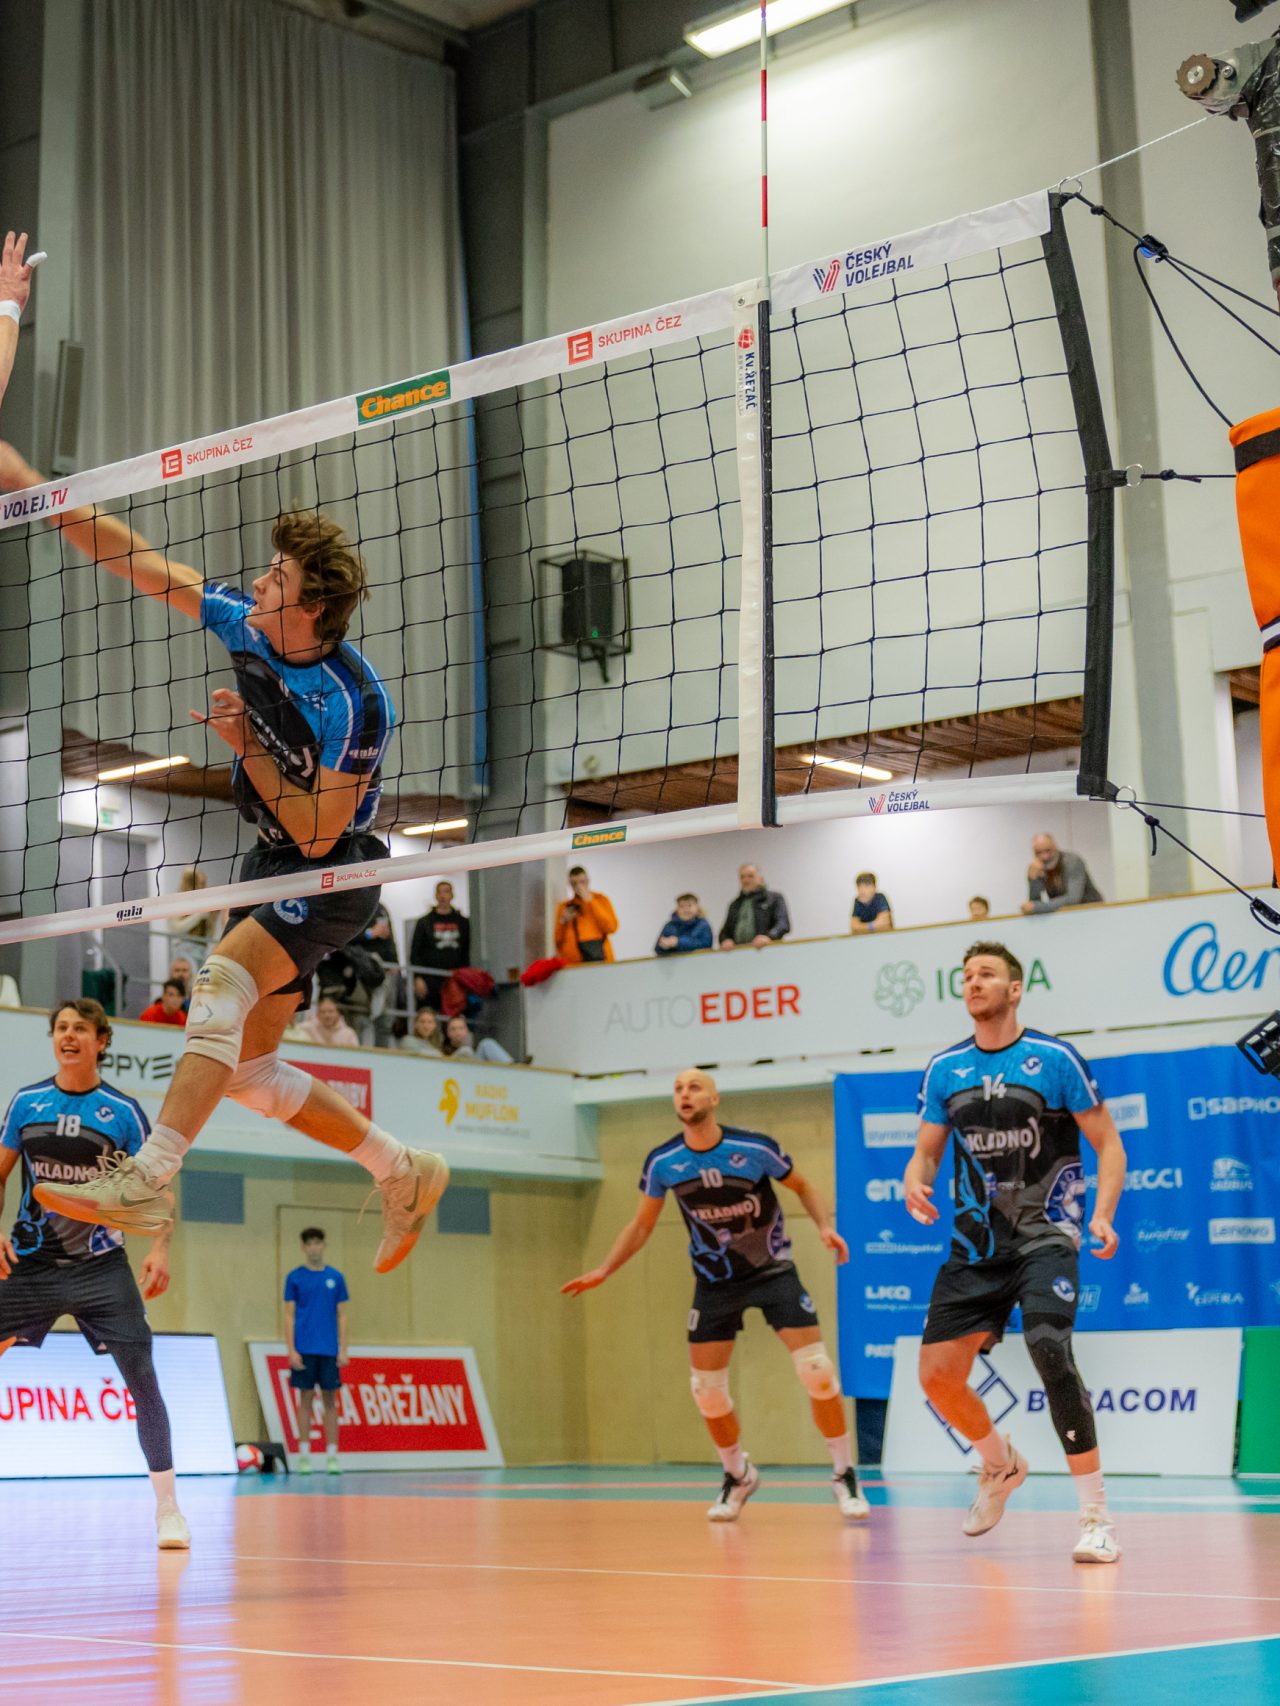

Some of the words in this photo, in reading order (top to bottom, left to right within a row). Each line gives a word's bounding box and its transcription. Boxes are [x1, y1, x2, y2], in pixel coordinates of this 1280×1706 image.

[845, 240, 892, 271] ČESKÝ
[845, 254, 915, 288] VOLEJBAL
[597, 323, 653, 349] SKUPINA
[654, 313, 682, 337] ČEZ
[361, 378, 448, 420] Chance
[186, 443, 231, 466] SKUPINA
[232, 436, 254, 456] ČEZ
[2, 487, 69, 521] VOLEJ.TV
[887, 799, 931, 813] VOLEJBAL
[889, 789, 918, 802] ČESKÝ
[574, 828, 626, 847] Chance
[336, 872, 364, 882] SKUPINA
[364, 869, 377, 878] ČEZ
[1163, 921, 1280, 996] Aer
[936, 959, 1052, 1001] IGA
[980, 1074, 1008, 1101] 14
[56, 1112, 81, 1138] 18
[968, 1128, 1033, 1152] KLADNO
[698, 1168, 722, 1188] 10
[697, 1201, 753, 1221] KLADNO
[688, 1308, 700, 1331] 0
[99, 1378, 137, 1420] ČE
[358, 1373, 468, 1426] BŘEŽANY
[1027, 1388, 1197, 1413] BACOM
